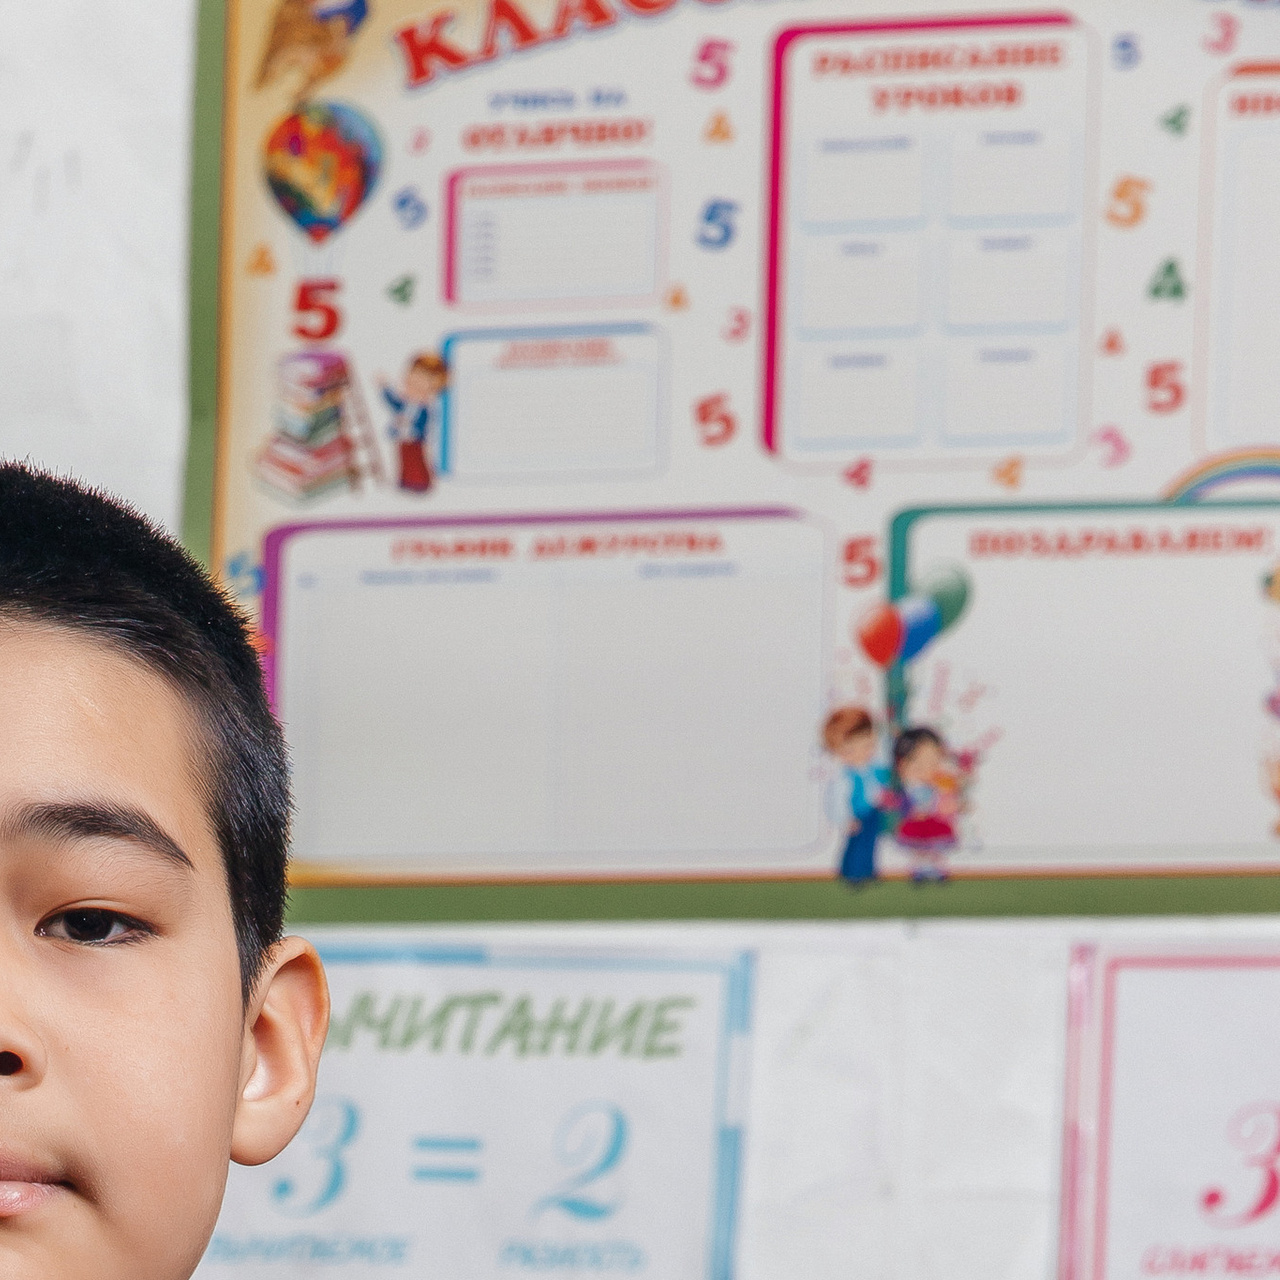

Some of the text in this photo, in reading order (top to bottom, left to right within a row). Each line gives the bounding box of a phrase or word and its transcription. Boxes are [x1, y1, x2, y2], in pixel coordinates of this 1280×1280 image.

[689, 36, 733, 89] 5
[695, 198, 741, 251] 5
[1104, 174, 1153, 230] 5
[291, 276, 344, 342] 5
[1145, 359, 1187, 415] 5
[694, 393, 738, 448] 5
[839, 533, 883, 588] 5
[412, 1132, 484, 1184] =
[526, 1100, 629, 1224] 2
